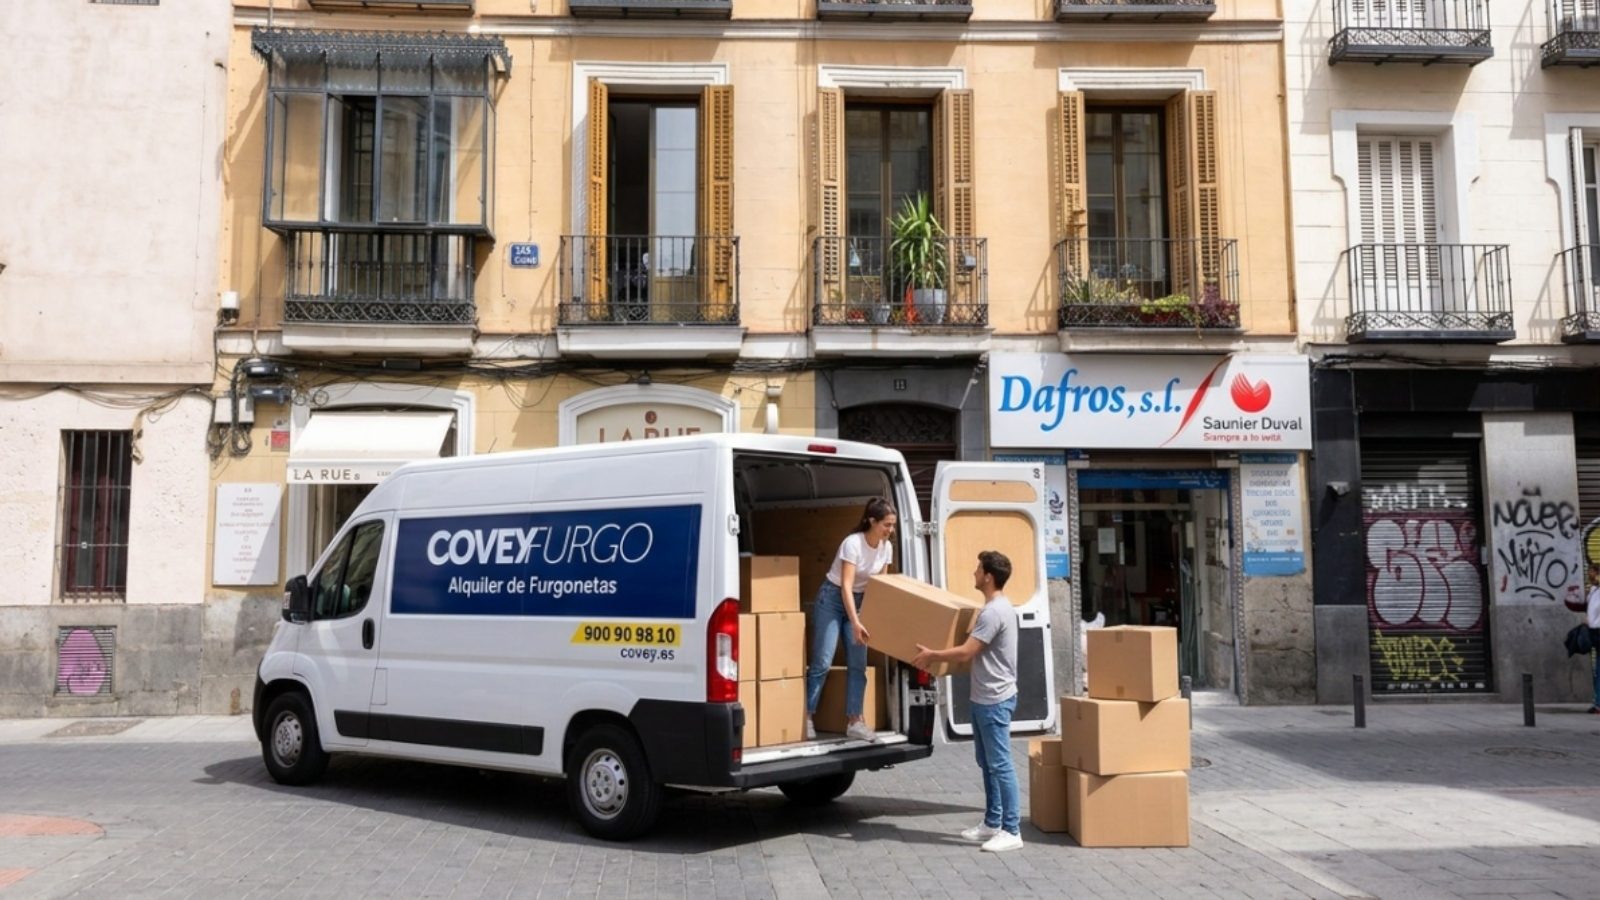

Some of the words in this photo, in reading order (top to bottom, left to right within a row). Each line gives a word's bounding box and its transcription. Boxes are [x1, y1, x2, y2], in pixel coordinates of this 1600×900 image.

[998, 368, 1135, 431] Dafros,
[1203, 416, 1258, 430] Saunier
[1261, 416, 1302, 430] Duval
[448, 576, 503, 598] Alquiler
[507, 577, 526, 594] de
[529, 576, 617, 598] Furgonetas
[584, 625, 611, 641] 900
[614, 626, 632, 642] 90
[635, 627, 654, 643] 98
[657, 627, 675, 643] 10
